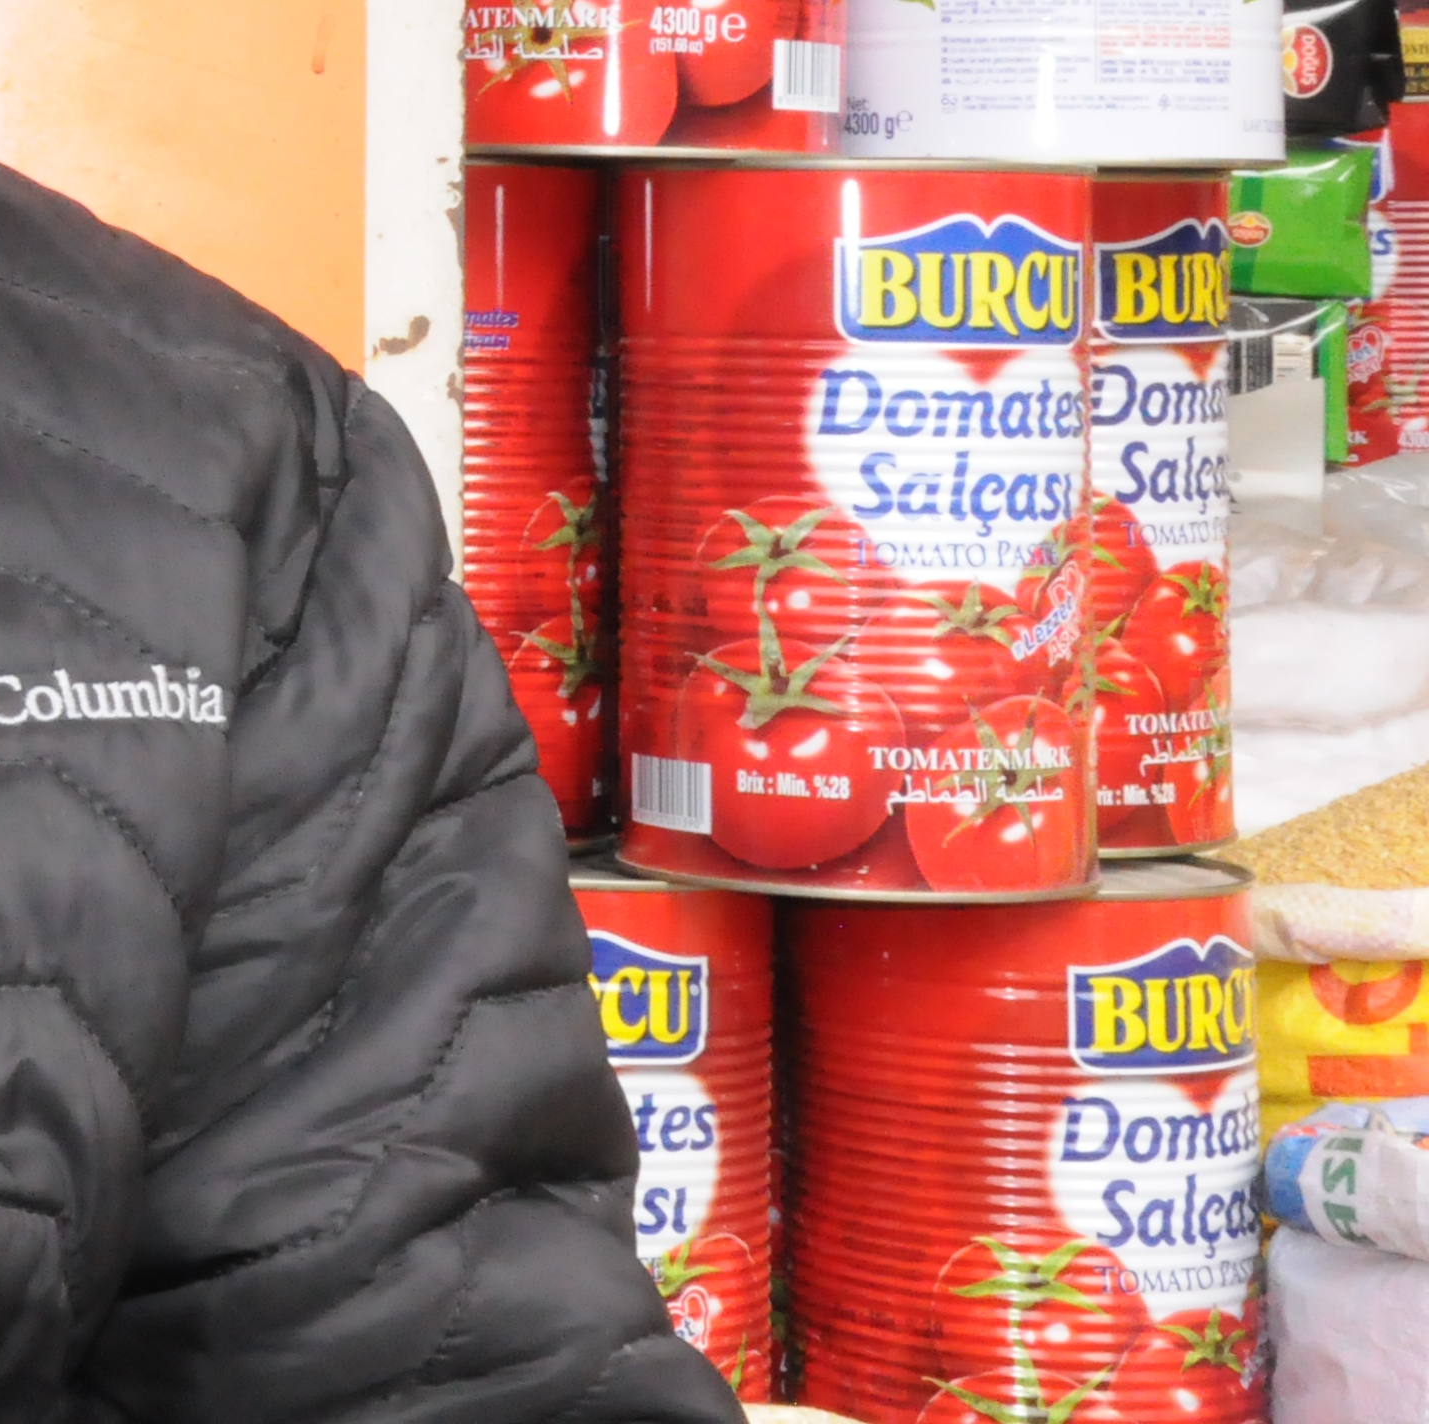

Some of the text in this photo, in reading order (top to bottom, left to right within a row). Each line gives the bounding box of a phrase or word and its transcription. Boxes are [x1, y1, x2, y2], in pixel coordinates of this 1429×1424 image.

[650, 6, 700, 35] 4300
[857, 249, 1076, 336] BURCU
[817, 369, 1084, 439] Domates
[851, 450, 1073, 536] Salçası
[854, 539, 987, 567] TOMATO
[868, 746, 1073, 771] TOMATENMARK
[814, 774, 851, 800] %28
